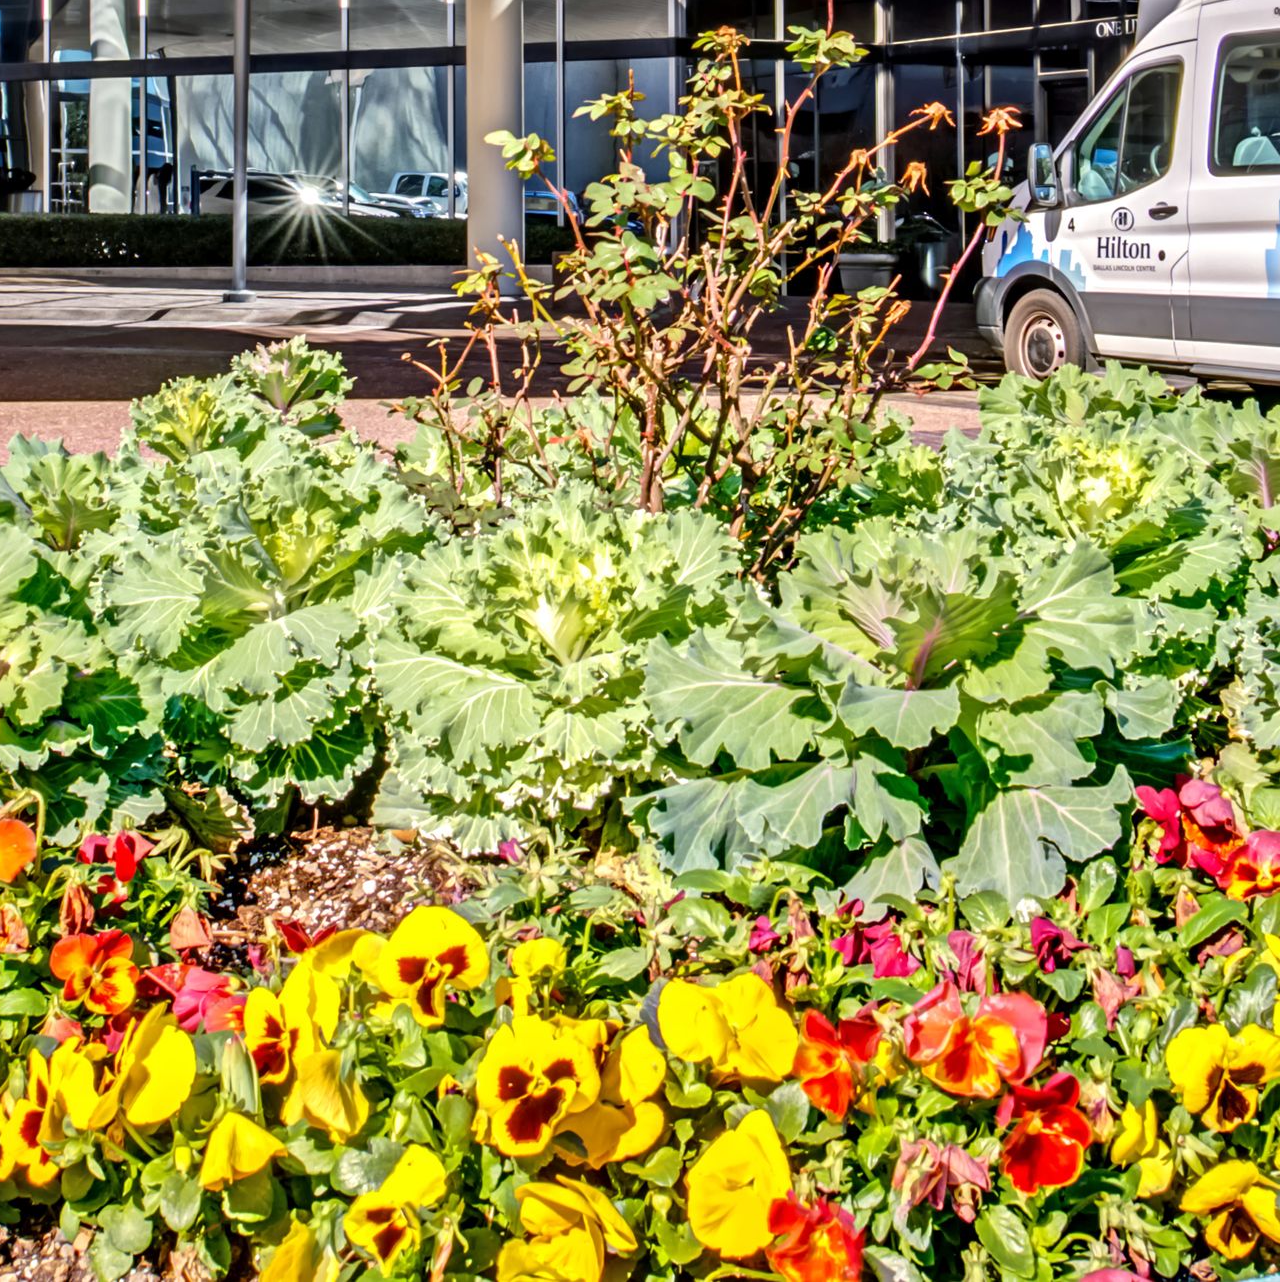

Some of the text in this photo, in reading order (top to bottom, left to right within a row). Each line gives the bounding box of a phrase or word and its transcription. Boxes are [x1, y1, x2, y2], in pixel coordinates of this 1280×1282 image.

[1095, 20, 1122, 38] ONE
[1067, 217, 1075, 232] 4
[1096, 236, 1151, 259] Hilton
